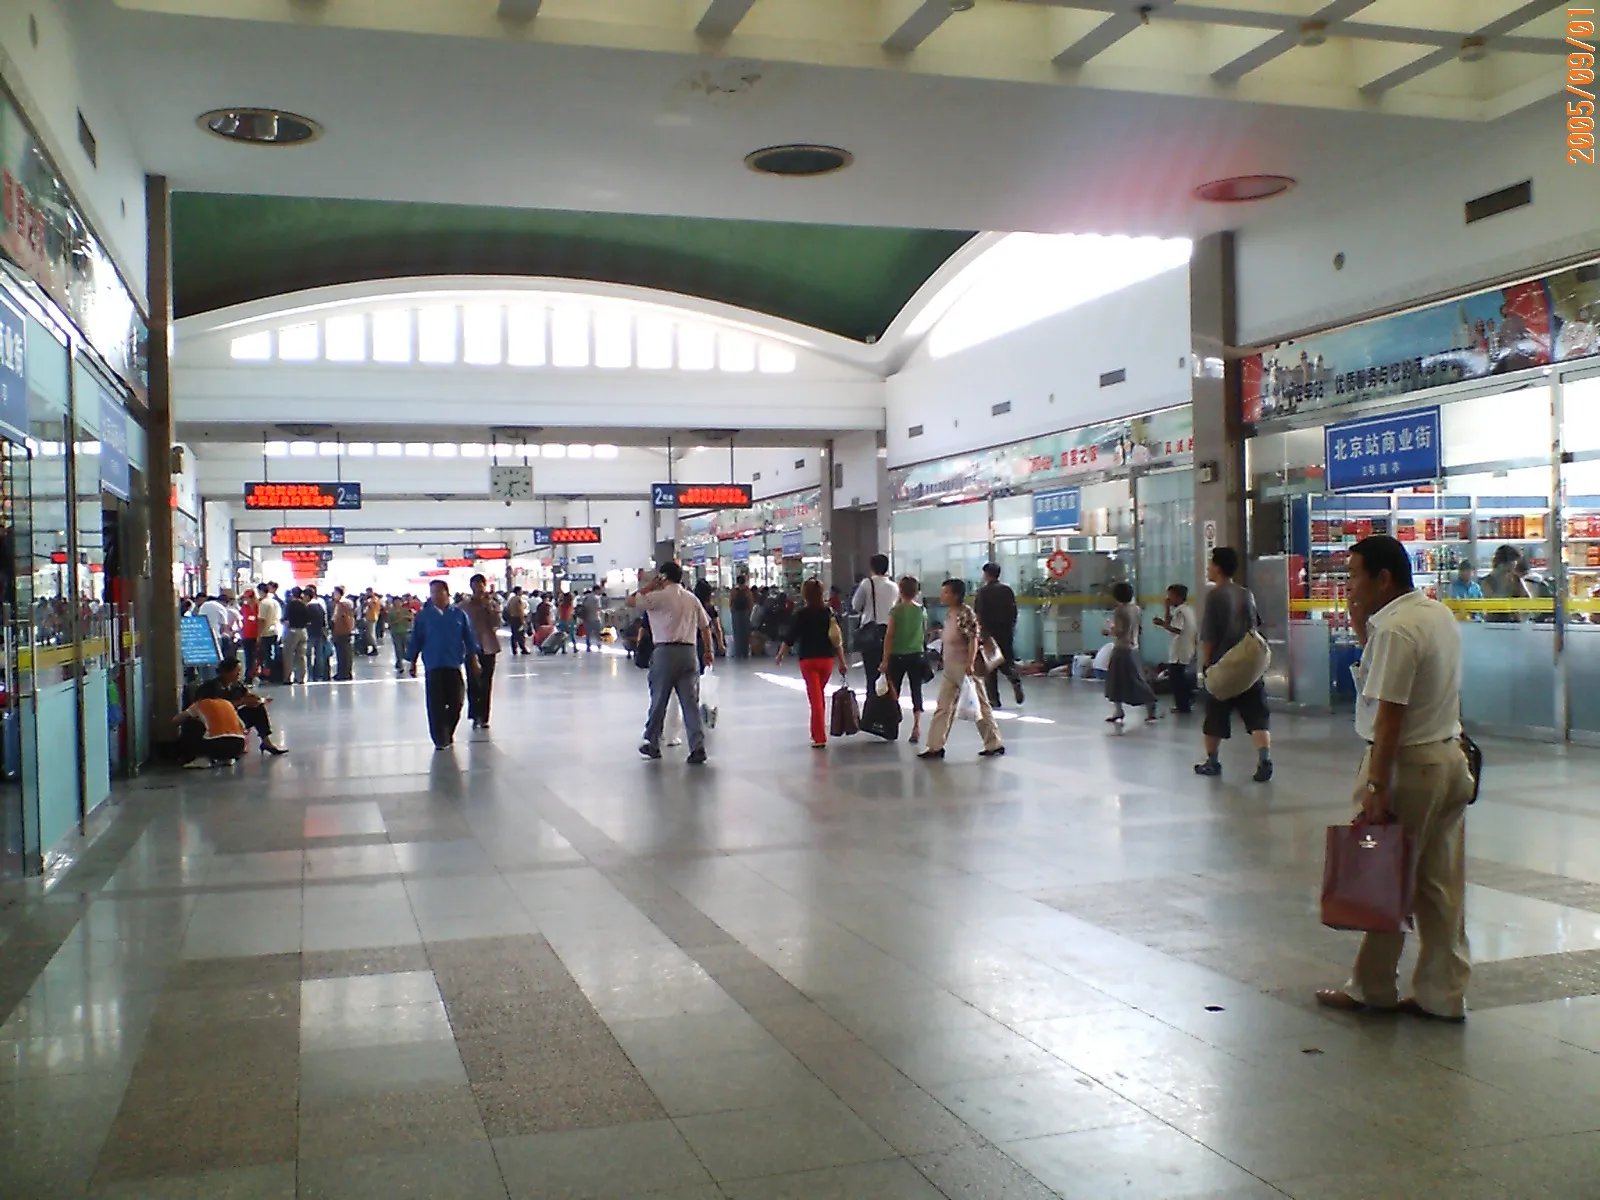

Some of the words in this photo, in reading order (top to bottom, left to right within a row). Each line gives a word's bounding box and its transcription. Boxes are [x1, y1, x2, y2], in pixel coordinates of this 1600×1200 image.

[1334, 425, 1431, 460] 北京站商业街
[337, 487, 346, 505] 2
[655, 487, 664, 505] 2
